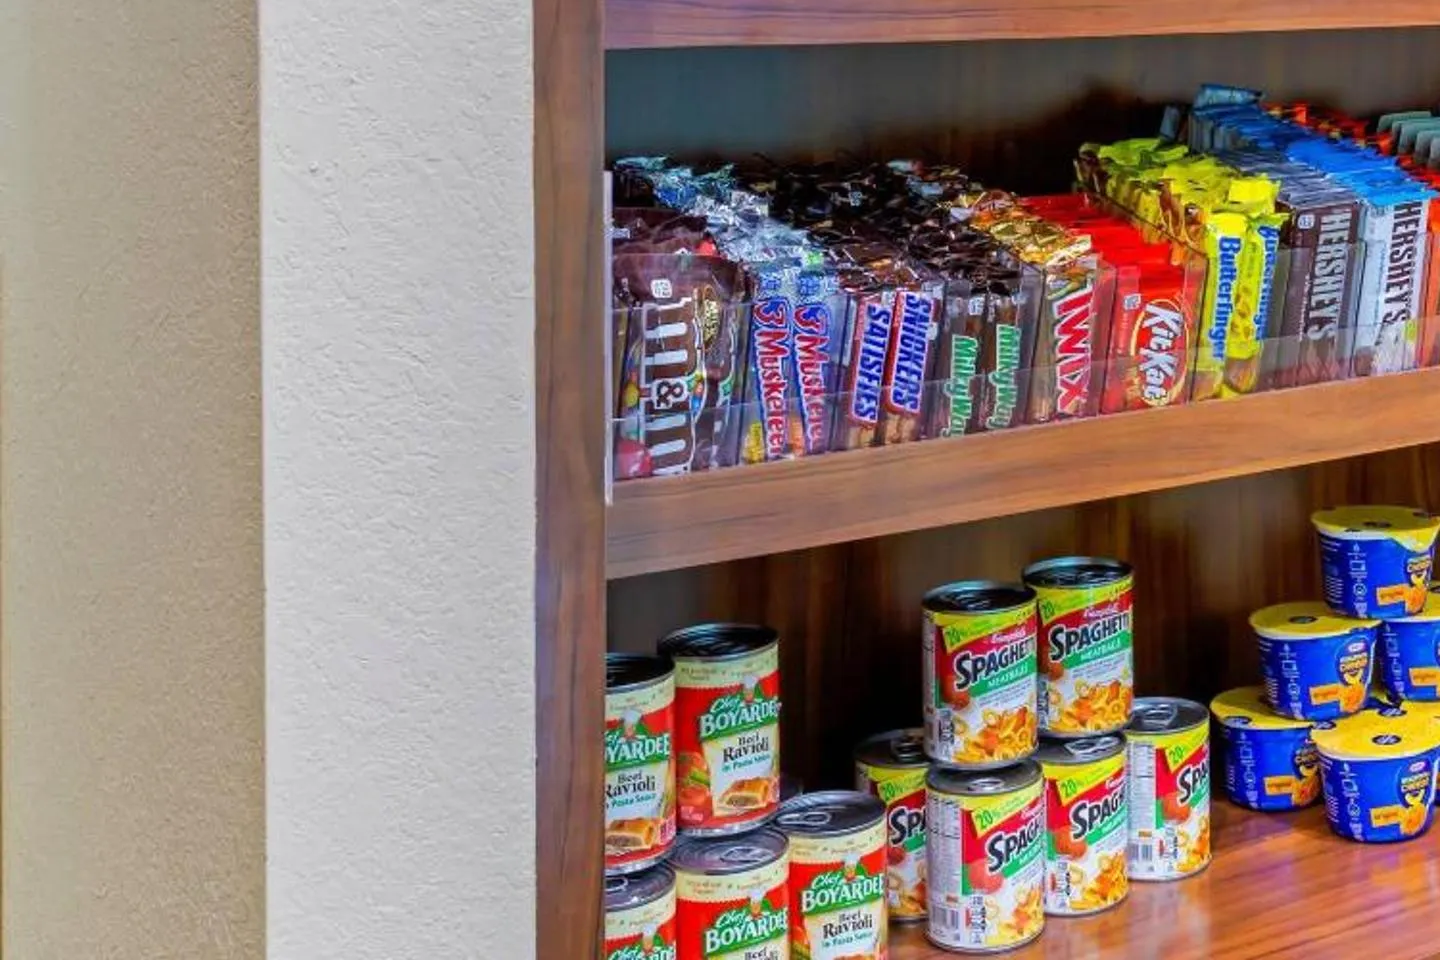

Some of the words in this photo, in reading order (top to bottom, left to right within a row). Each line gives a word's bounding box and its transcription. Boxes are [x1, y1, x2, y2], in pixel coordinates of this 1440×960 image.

[1307, 209, 1352, 341] HERSHEY'S
[1382, 200, 1424, 330] HERSHEY'S
[753, 296, 790, 326] 3
[793, 303, 831, 332] 3
[1139, 302, 1184, 350] Kit
[1208, 234, 1244, 360] Butterfinger
[854, 303, 891, 422] SATISFIES
[893, 292, 932, 411] SNICKERS
[943, 335, 979, 398] Milky
[1053, 278, 1095, 414] TWIX
[1138, 346, 1180, 400] Kat
[604, 732, 671, 764] YARDEE
[722, 736, 769, 764] Ravioli
[822, 914, 873, 940] Ravioli
